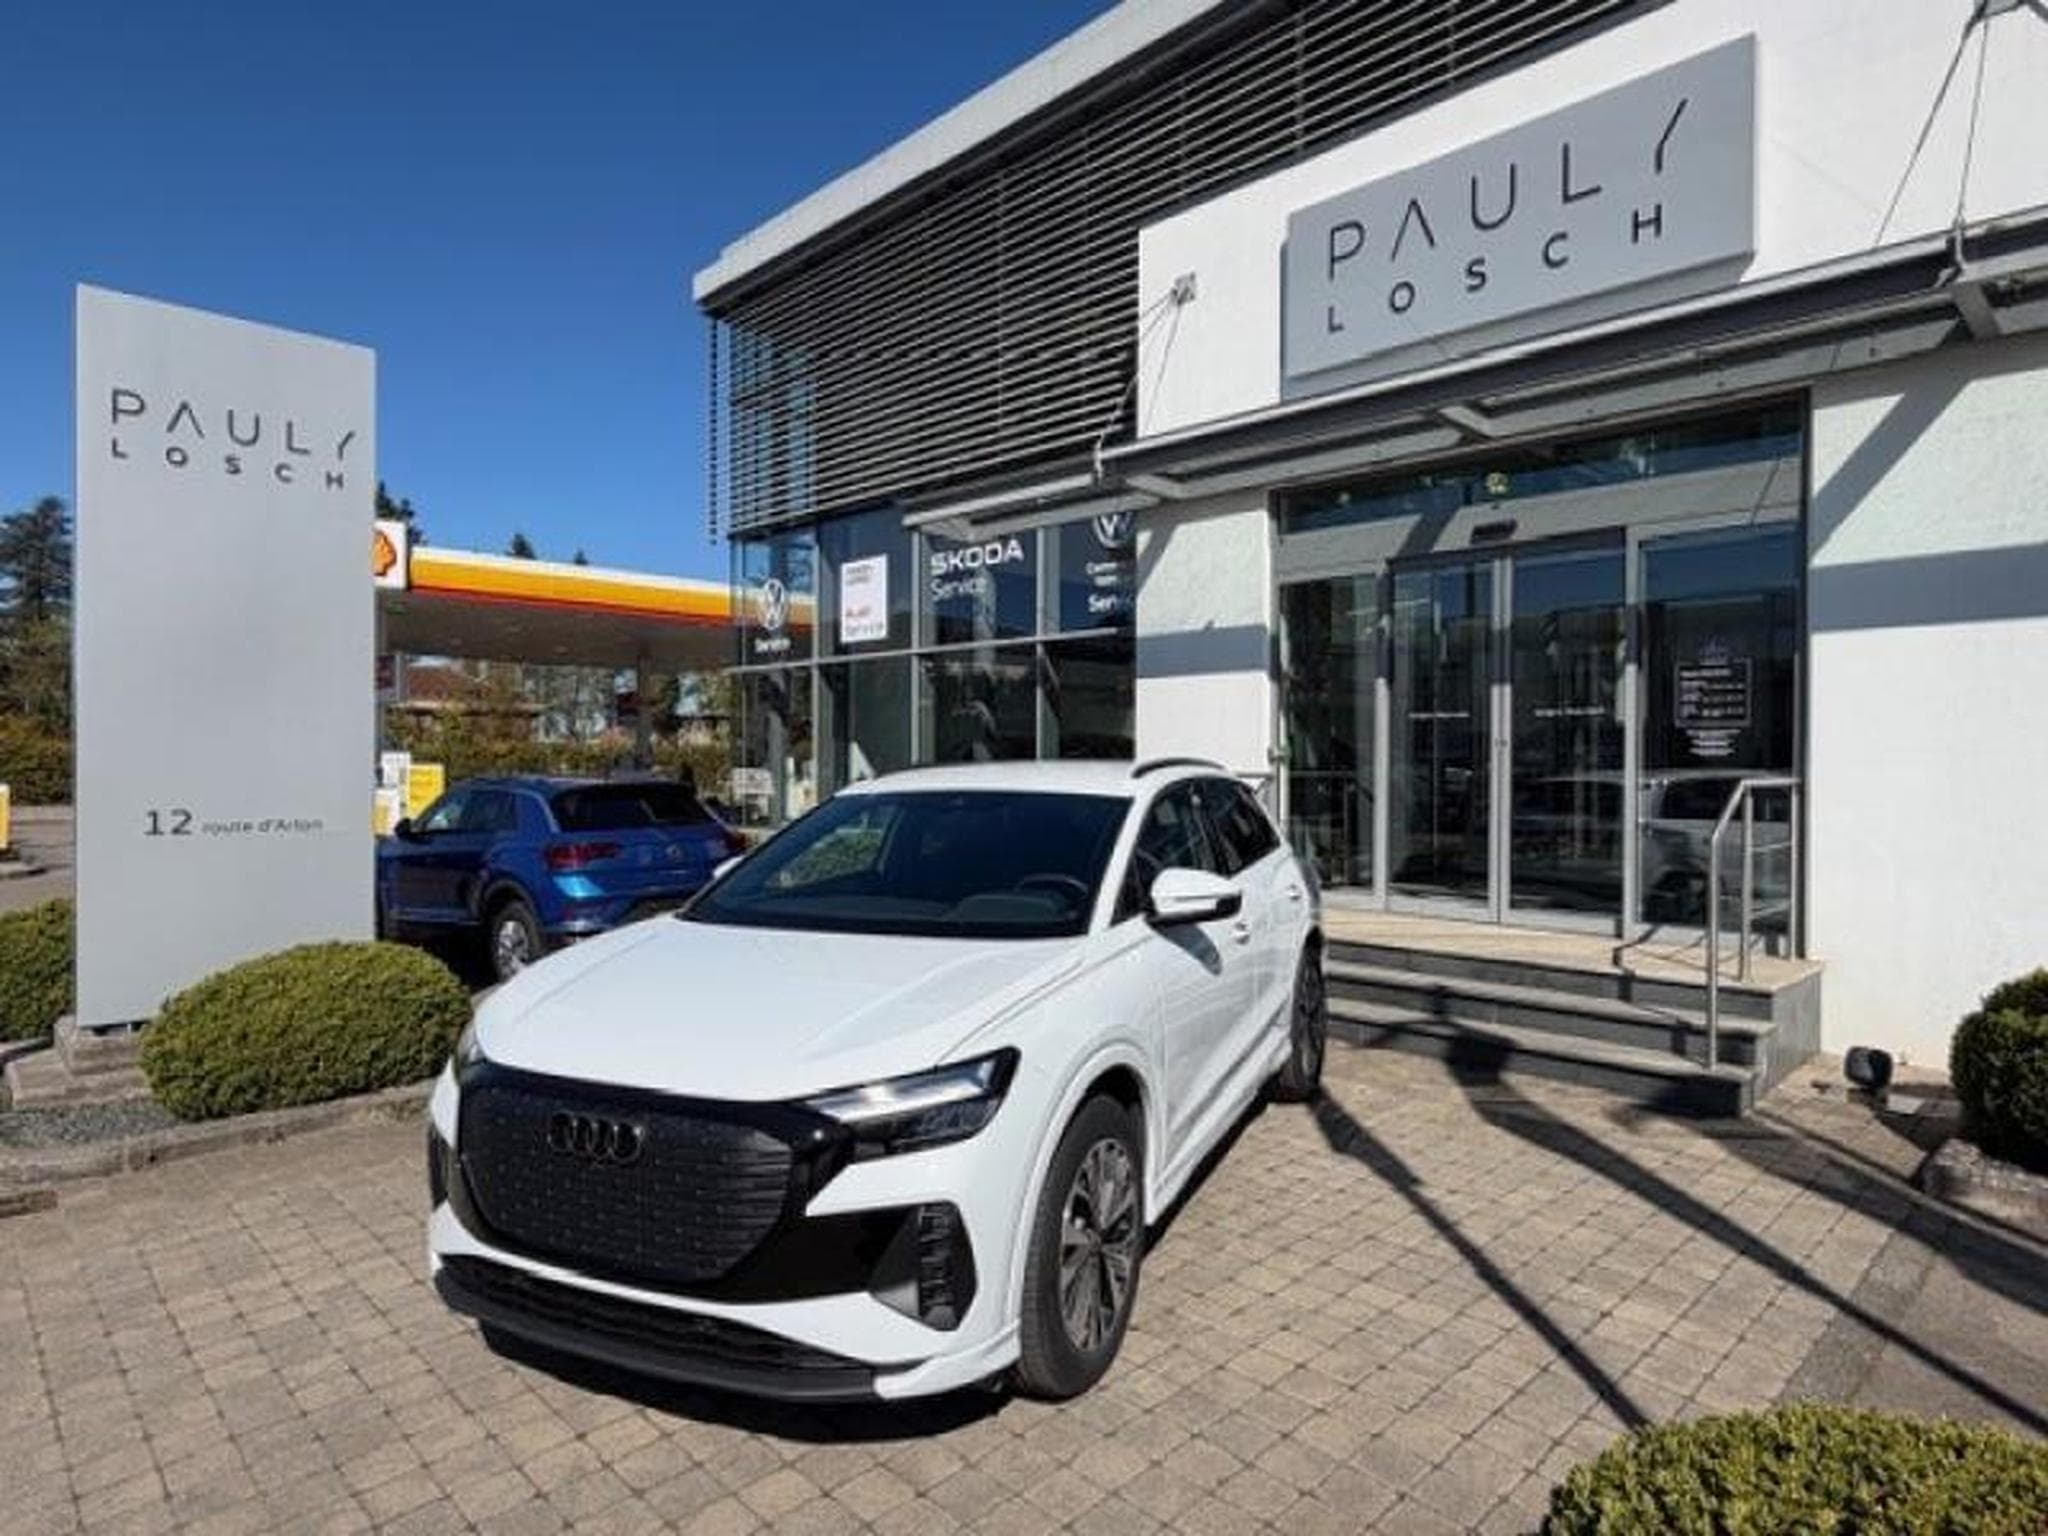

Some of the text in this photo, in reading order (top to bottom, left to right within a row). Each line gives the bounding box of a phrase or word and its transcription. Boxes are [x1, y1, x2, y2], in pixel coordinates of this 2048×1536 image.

[1330, 98, 1689, 280] PAULY
[1327, 203, 1663, 333] LOSCH
[111, 387, 356, 461] PAULY
[111, 437, 345, 489] LOSCH
[143, 808, 193, 836] 12
